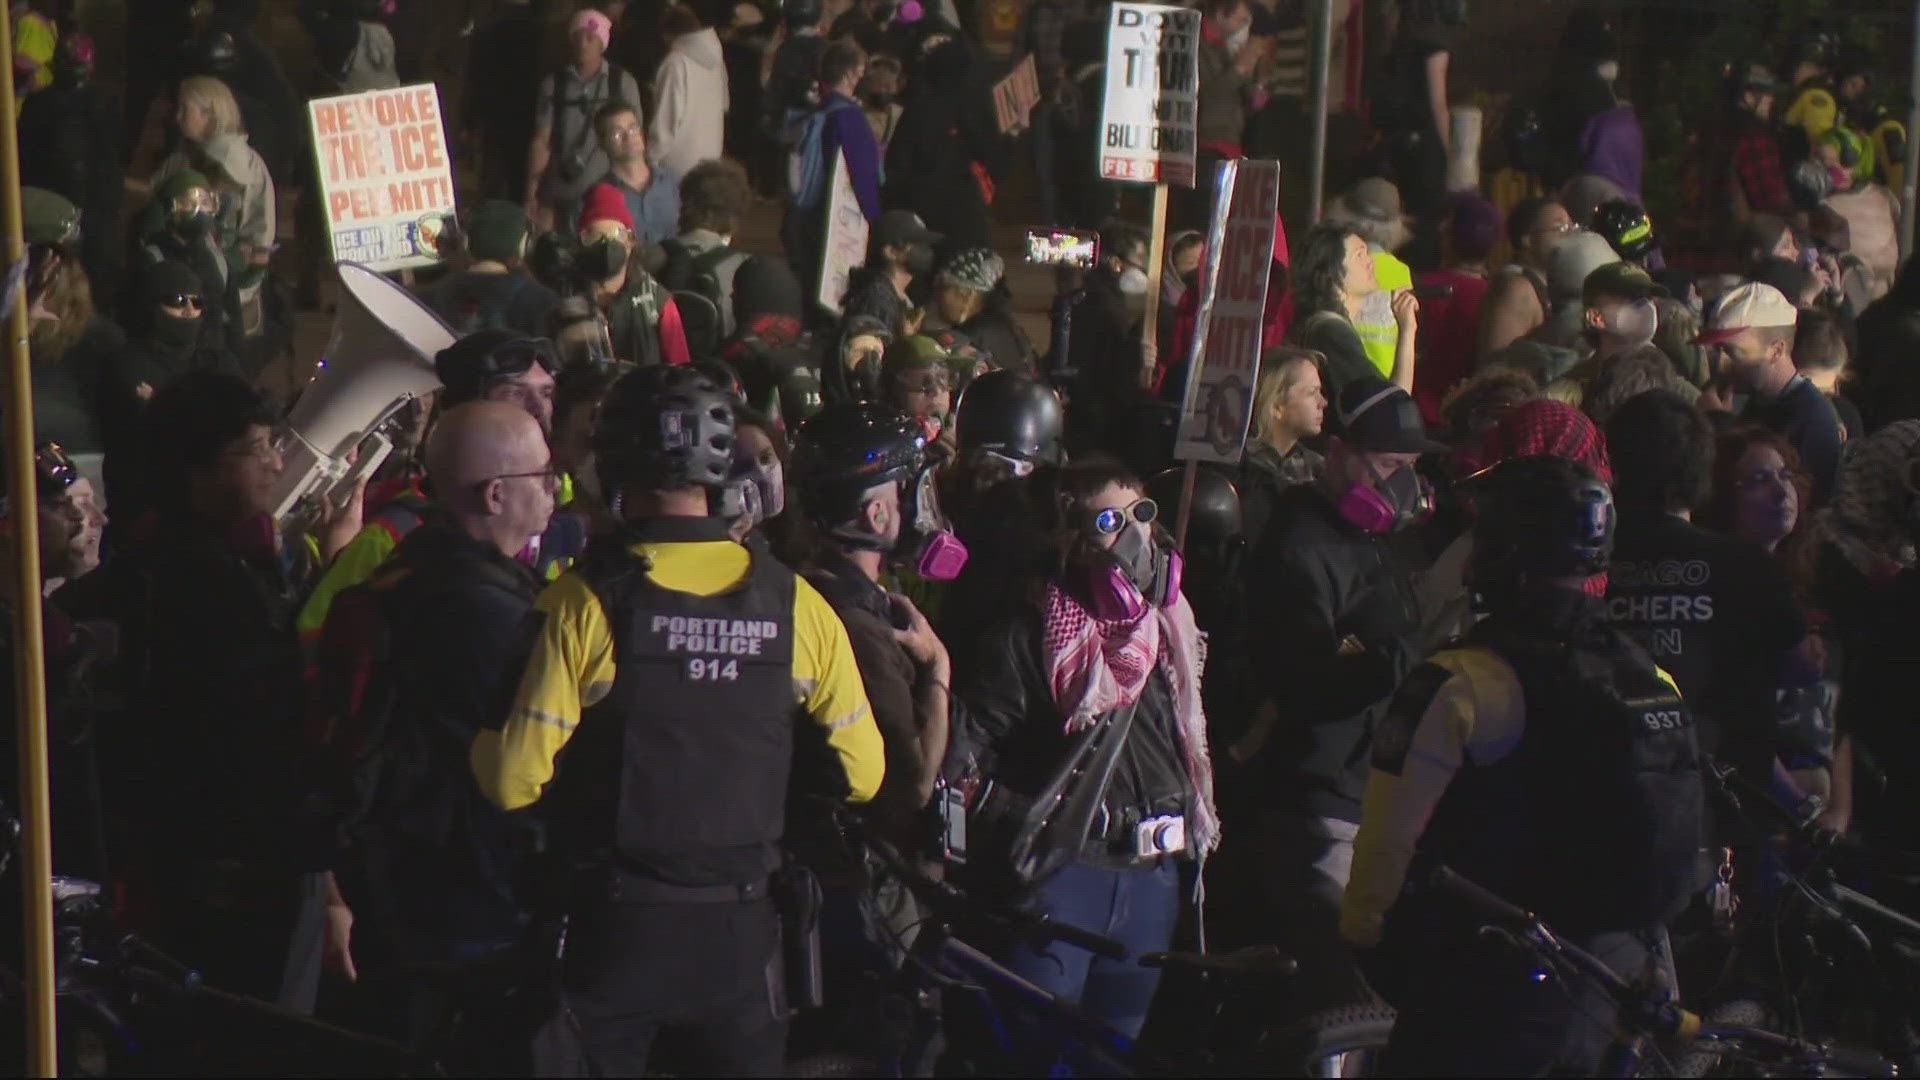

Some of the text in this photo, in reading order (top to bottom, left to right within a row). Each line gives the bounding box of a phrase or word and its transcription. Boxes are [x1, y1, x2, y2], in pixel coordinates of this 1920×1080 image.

[314, 90, 435, 135] REVOKE
[322, 124, 443, 183] THE ICE
[329, 177, 449, 222] PERMIT!
[1616, 560, 1711, 586] CAGO
[1610, 595, 1714, 621] CHERS
[651, 615, 778, 639] PORTLAND
[668, 634, 762, 655] POLICE
[689, 658, 739, 680] 914
[1644, 711, 1682, 729] 937
